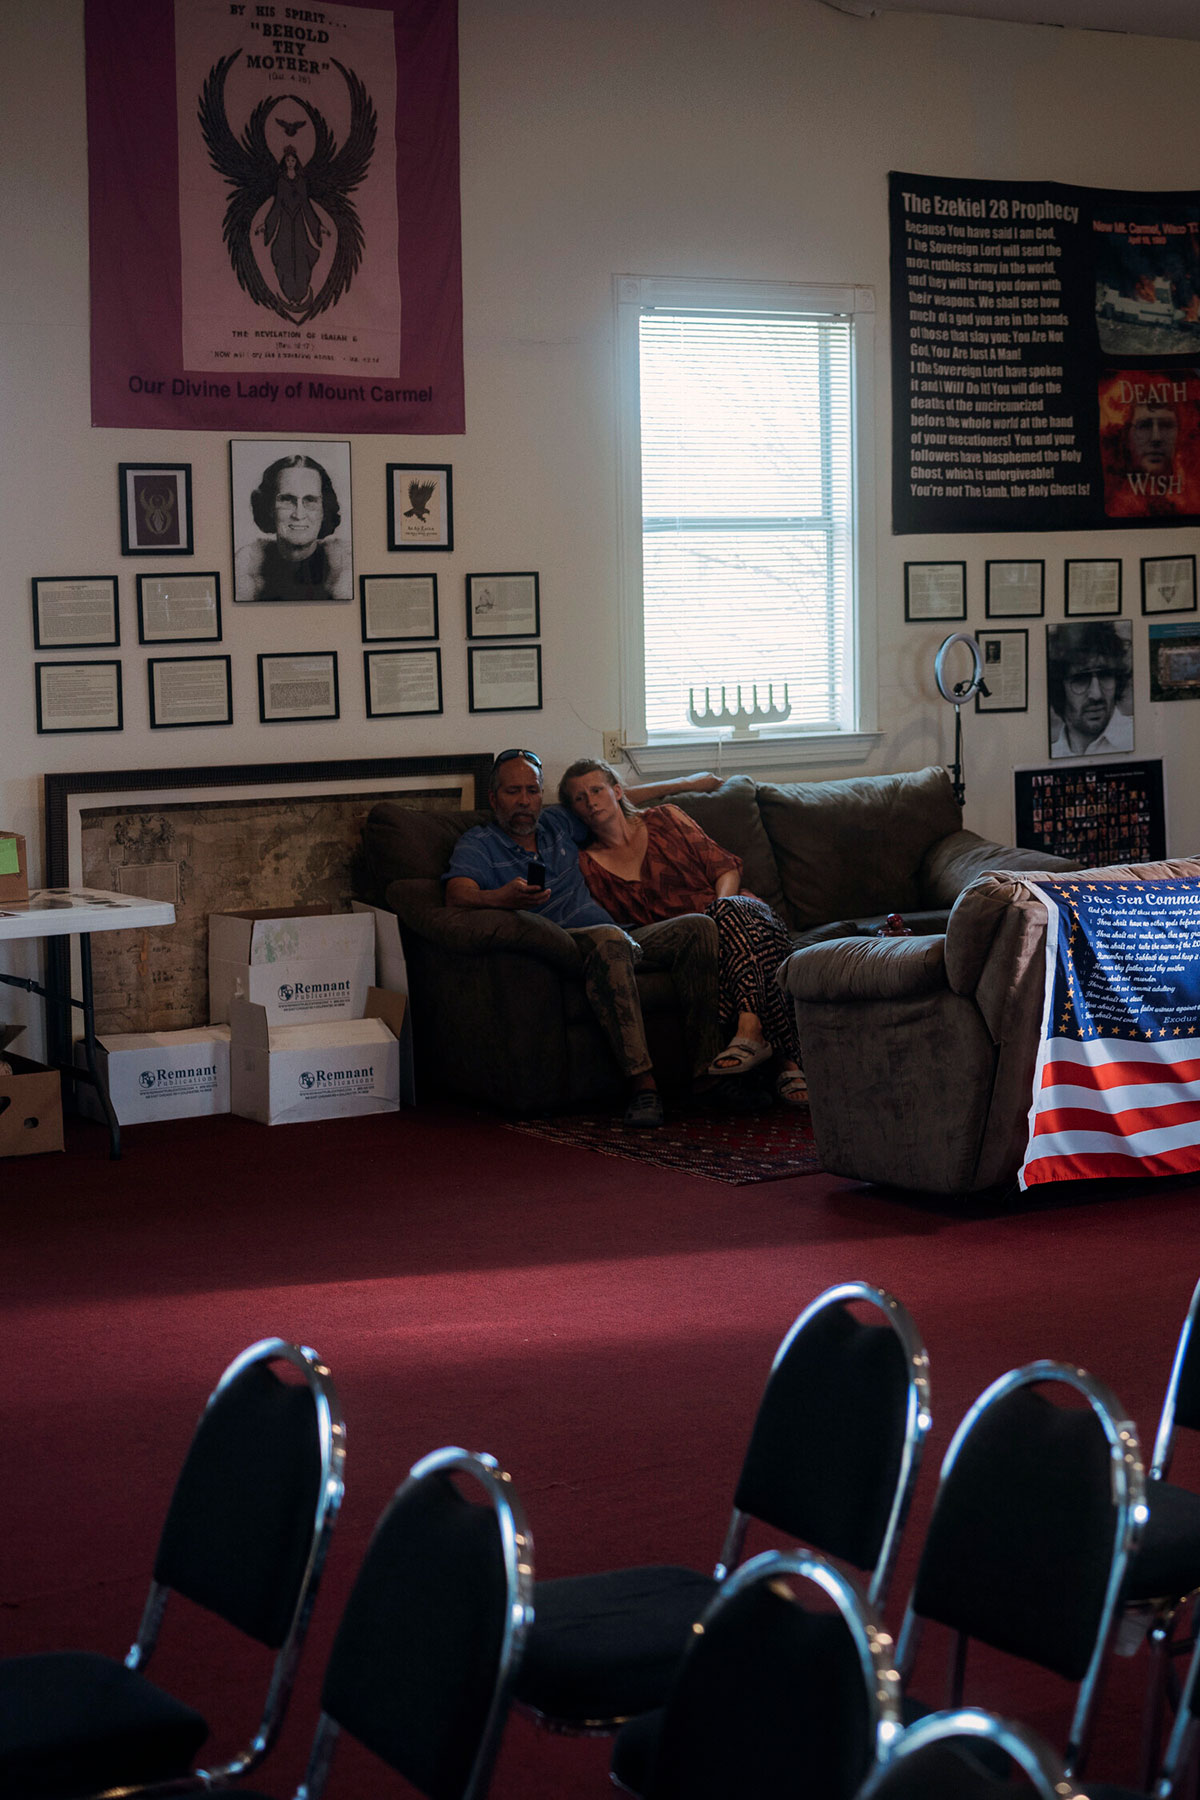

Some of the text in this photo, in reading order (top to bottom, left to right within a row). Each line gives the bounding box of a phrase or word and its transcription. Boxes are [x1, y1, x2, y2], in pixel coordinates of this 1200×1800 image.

[230, 4, 245, 16] BY
[256, 6, 275, 17] HIS
[273, 41, 306, 55] THY
[902, 192, 1080, 224] The Ezekiel 28 Prophecy
[931, 259, 972, 273] ruthless
[973, 262, 998, 275] army
[1000, 262, 1009, 274] in
[1010, 262, 1025, 274] the
[930, 345, 950, 358] You
[952, 347, 968, 360] Are
[969, 347, 988, 361] Just
[989, 348, 997, 360] A
[998, 347, 1022, 361] Man!
[129, 375, 433, 403] Our Divine Lady of Mount Carmel
[1119, 380, 1188, 405] DEATH
[911, 448, 1082, 465] followers have blasphemed the Holy
[945, 467, 974, 480] which
[975, 467, 984, 480] is
[911, 484, 943, 497] You're
[945, 485, 962, 497] not
[965, 485, 982, 497] The
[1010, 485, 1027, 497] the
[1028, 484, 1049, 498] Holy
[1050, 484, 1076, 496] Ghost
[1127, 472, 1182, 496] WISH
[1082, 895, 1112, 905] The
[1116, 895, 1144, 905] Ten
[295, 979, 351, 994] Remnant
[1163, 1015, 1197, 1024] Exodus
[157, 1064, 217, 1080] Remnant
[315, 1066, 374, 1081] Remnant
